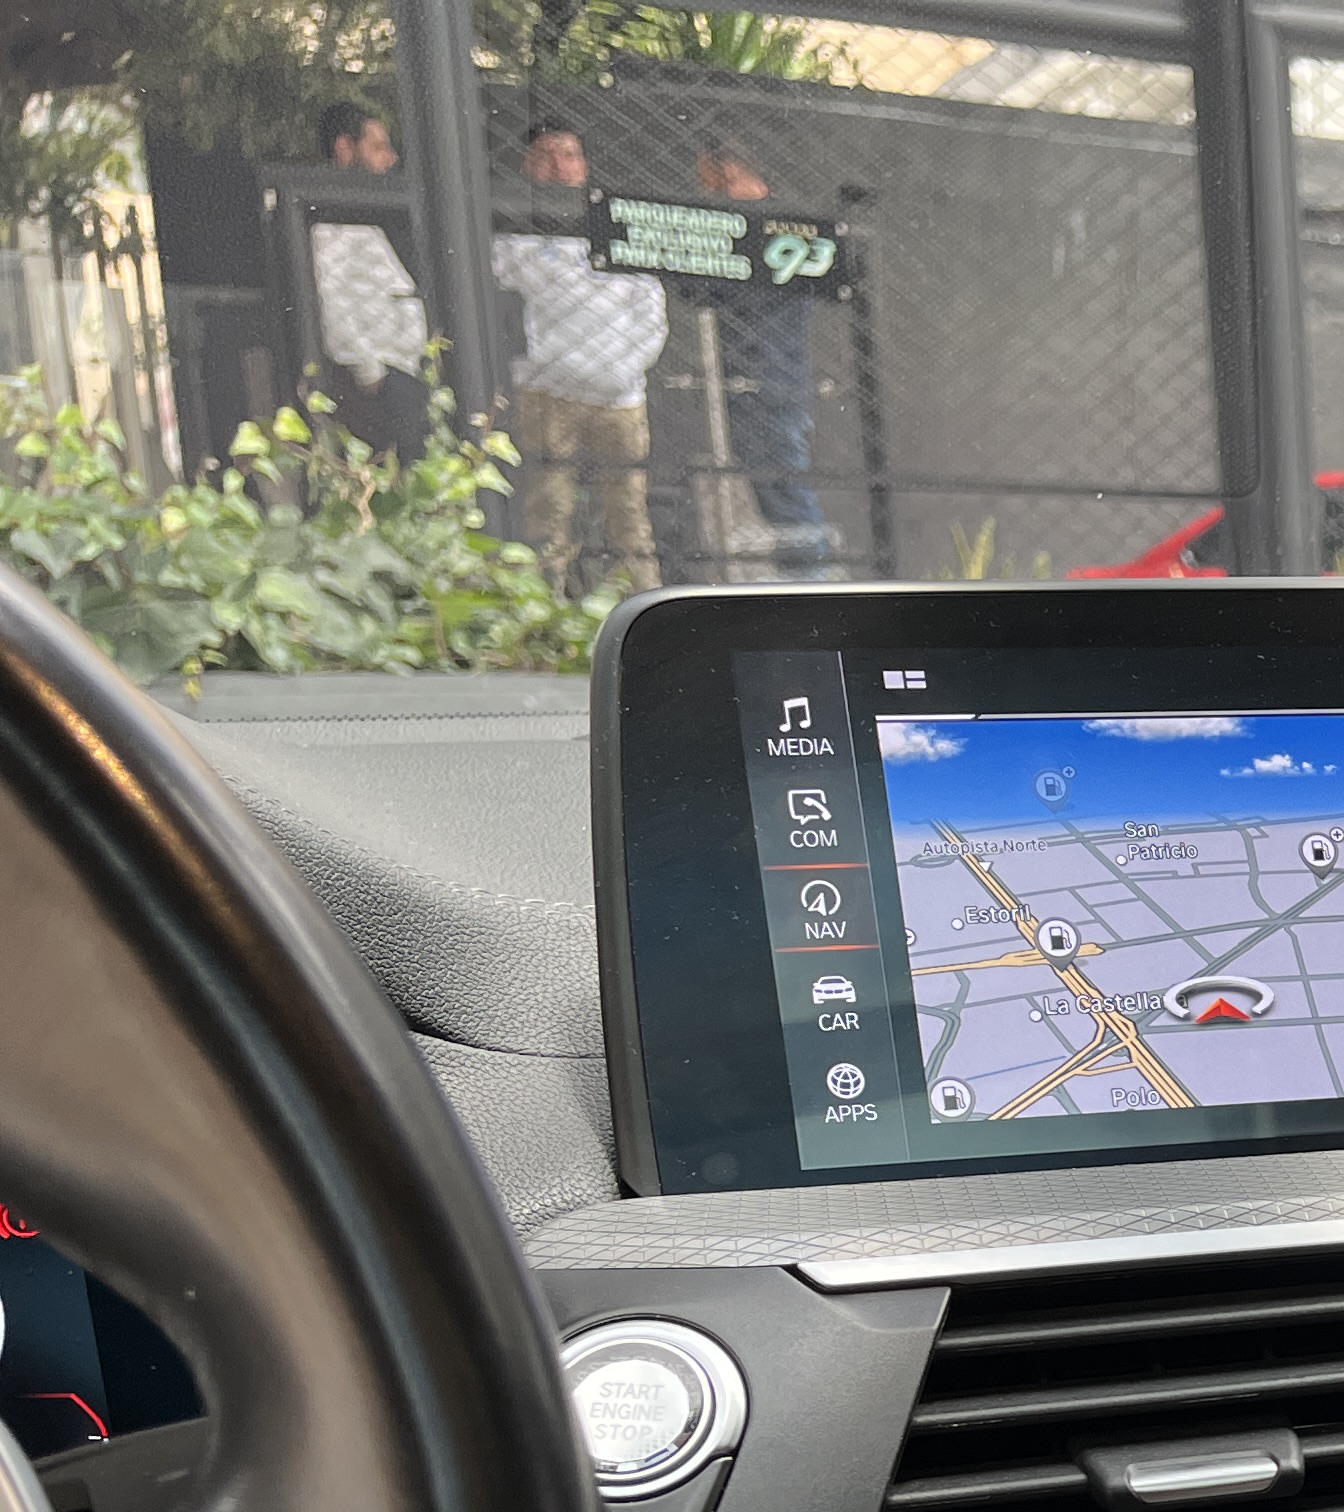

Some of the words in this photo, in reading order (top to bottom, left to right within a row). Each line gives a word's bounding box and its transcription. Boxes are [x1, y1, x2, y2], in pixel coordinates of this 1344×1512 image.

[767, 737, 835, 757] MEDIA
[789, 830, 838, 848] COM
[1123, 821, 1159, 838] San
[923, 840, 999, 856] Autopista
[1003, 838, 1047, 853] Norte
[1127, 843, 1198, 860] Patricio
[964, 904, 1031, 925] Estoril
[804, 920, 847, 940] NAV
[1044, 996, 1070, 1016] La
[1075, 992, 1188, 1013] Castellaa
[818, 1012, 860, 1031] CAR
[1111, 1088, 1160, 1107] Polo
[824, 1104, 878, 1123] APPS
[599, 1382, 664, 1400] START
[590, 1402, 665, 1422] ENGINE
[594, 1423, 653, 1441] STOP
